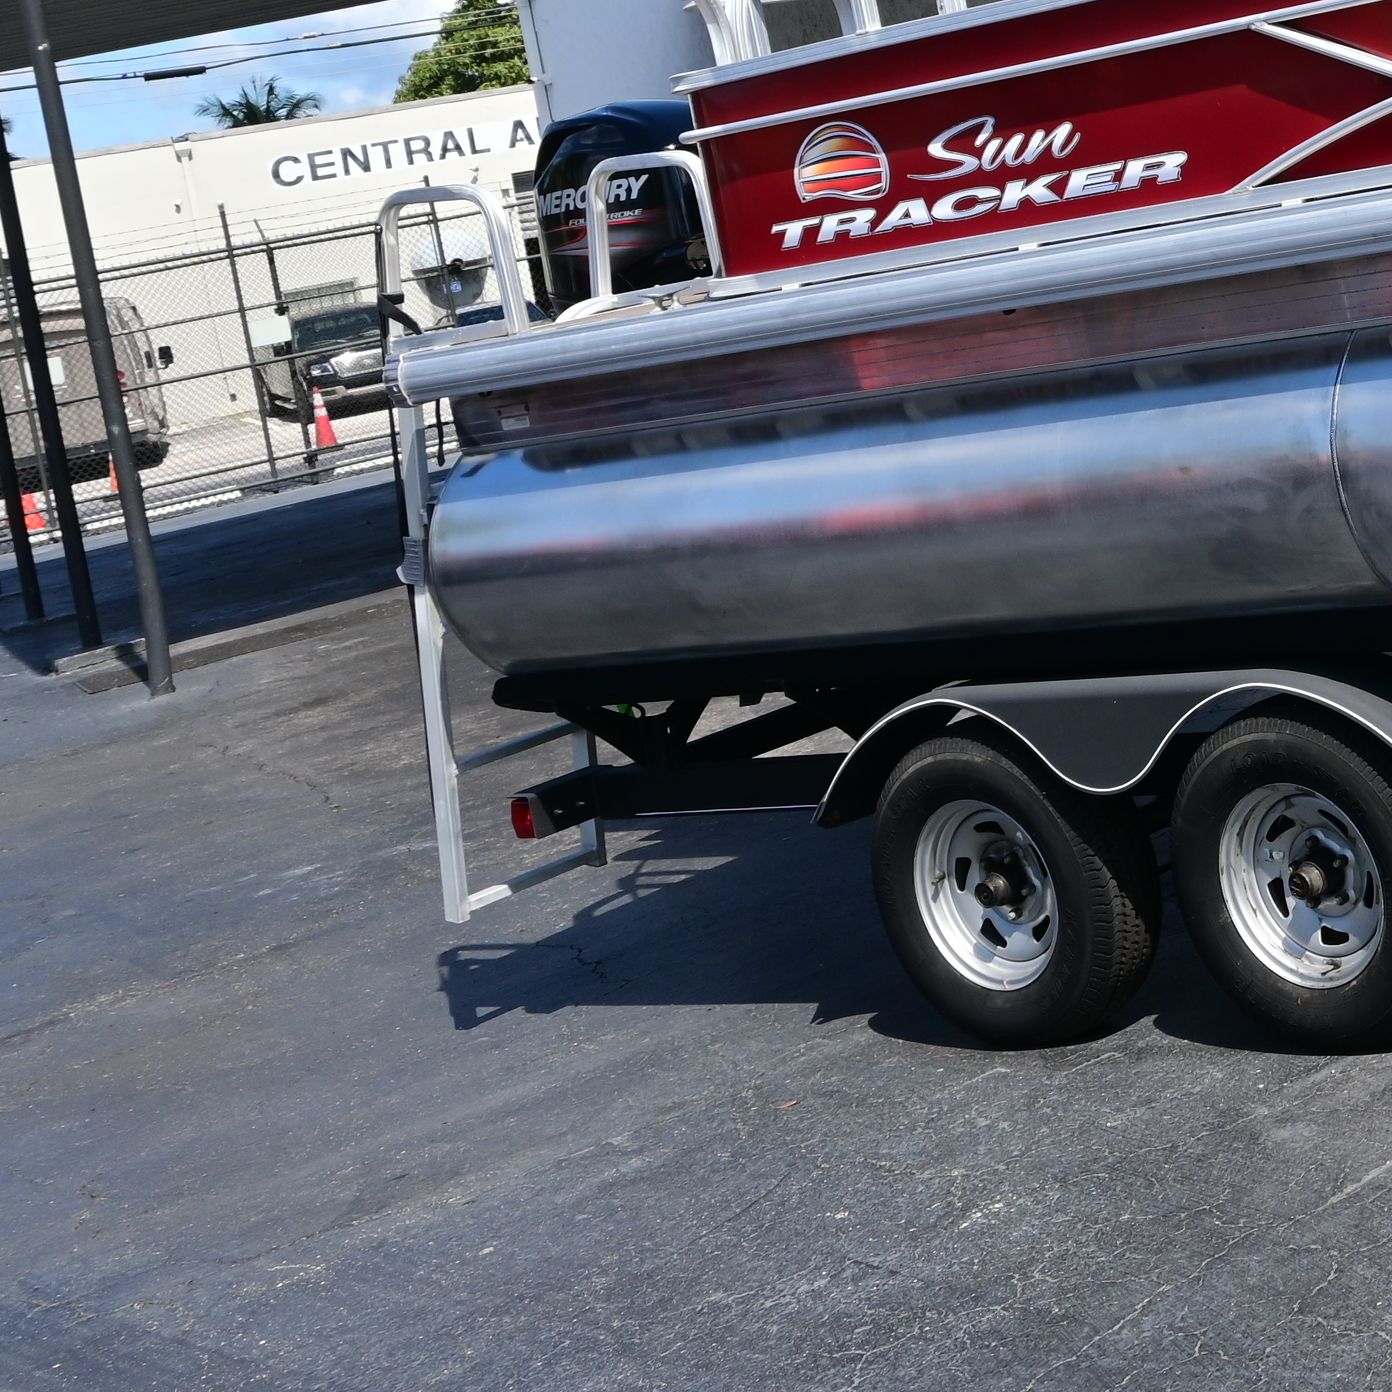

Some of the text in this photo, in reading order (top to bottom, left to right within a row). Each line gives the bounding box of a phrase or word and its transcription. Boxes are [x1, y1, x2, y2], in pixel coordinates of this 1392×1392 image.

[271, 116, 541, 187] CENTRAL A
[906, 114, 1081, 181] Sun
[539, 174, 649, 217] MERCRY
[770, 150, 1189, 250] TRACKER
